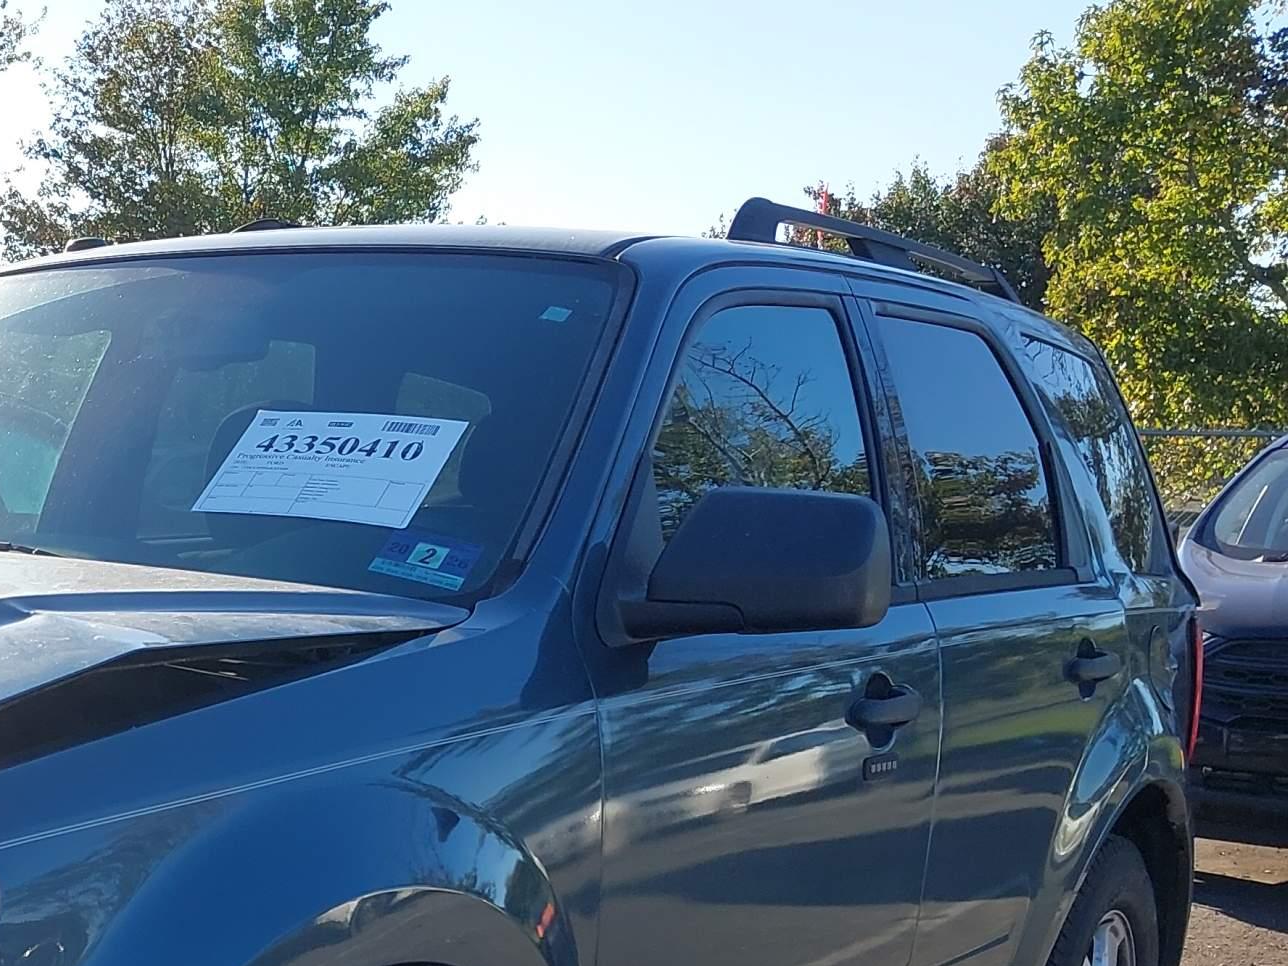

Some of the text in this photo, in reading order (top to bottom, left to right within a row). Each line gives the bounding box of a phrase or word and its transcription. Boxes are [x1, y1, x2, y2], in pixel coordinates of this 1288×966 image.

[256, 433, 424, 462] 43350410
[236, 452, 366, 465] Progressive Casualty Insurance
[419, 548, 438, 565] 2
